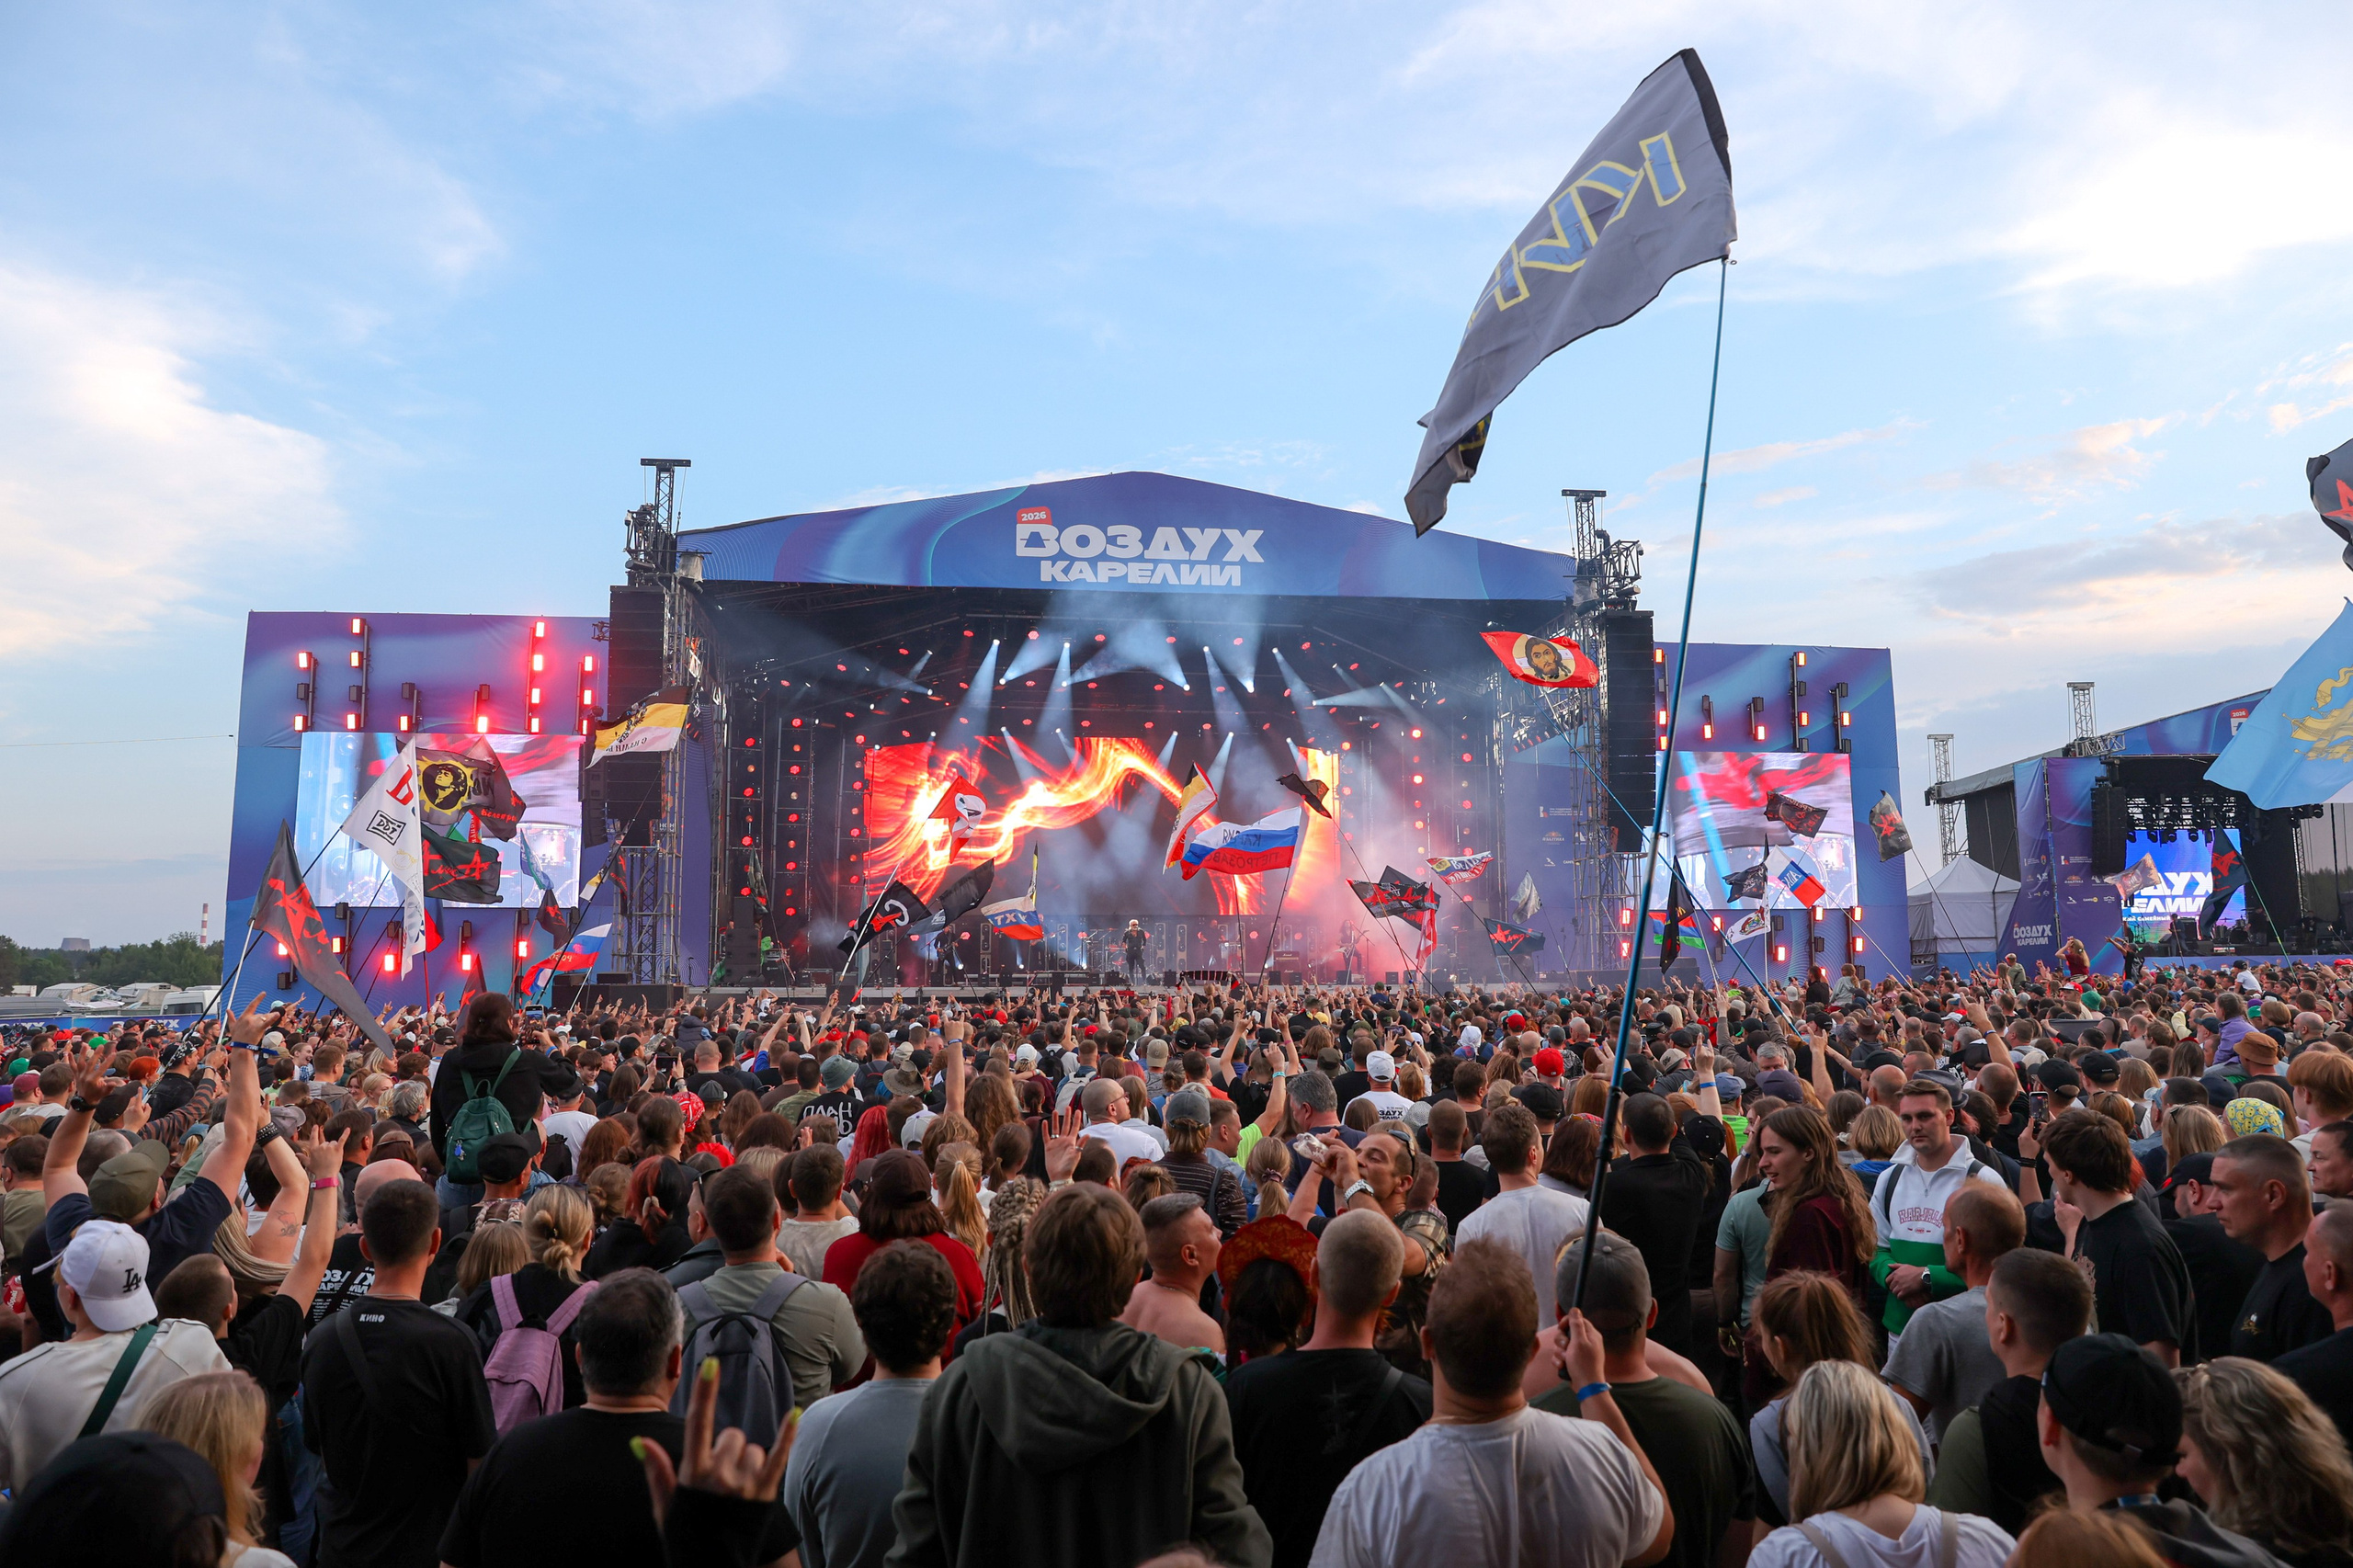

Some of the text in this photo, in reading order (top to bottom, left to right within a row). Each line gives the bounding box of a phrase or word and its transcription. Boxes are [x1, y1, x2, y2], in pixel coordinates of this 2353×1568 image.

[1021, 511, 1047, 521] 2026
[1016, 523, 1265, 562] ВОЗДУХ
[1040, 561, 1241, 586] КАРЕЛИИ
[2014, 925, 2052, 938] ВОЗДУХ
[2018, 937, 2049, 946] КАРЕЛИИ
[122, 1267, 142, 1293] LA
[359, 1314, 385, 1323] КИНО
